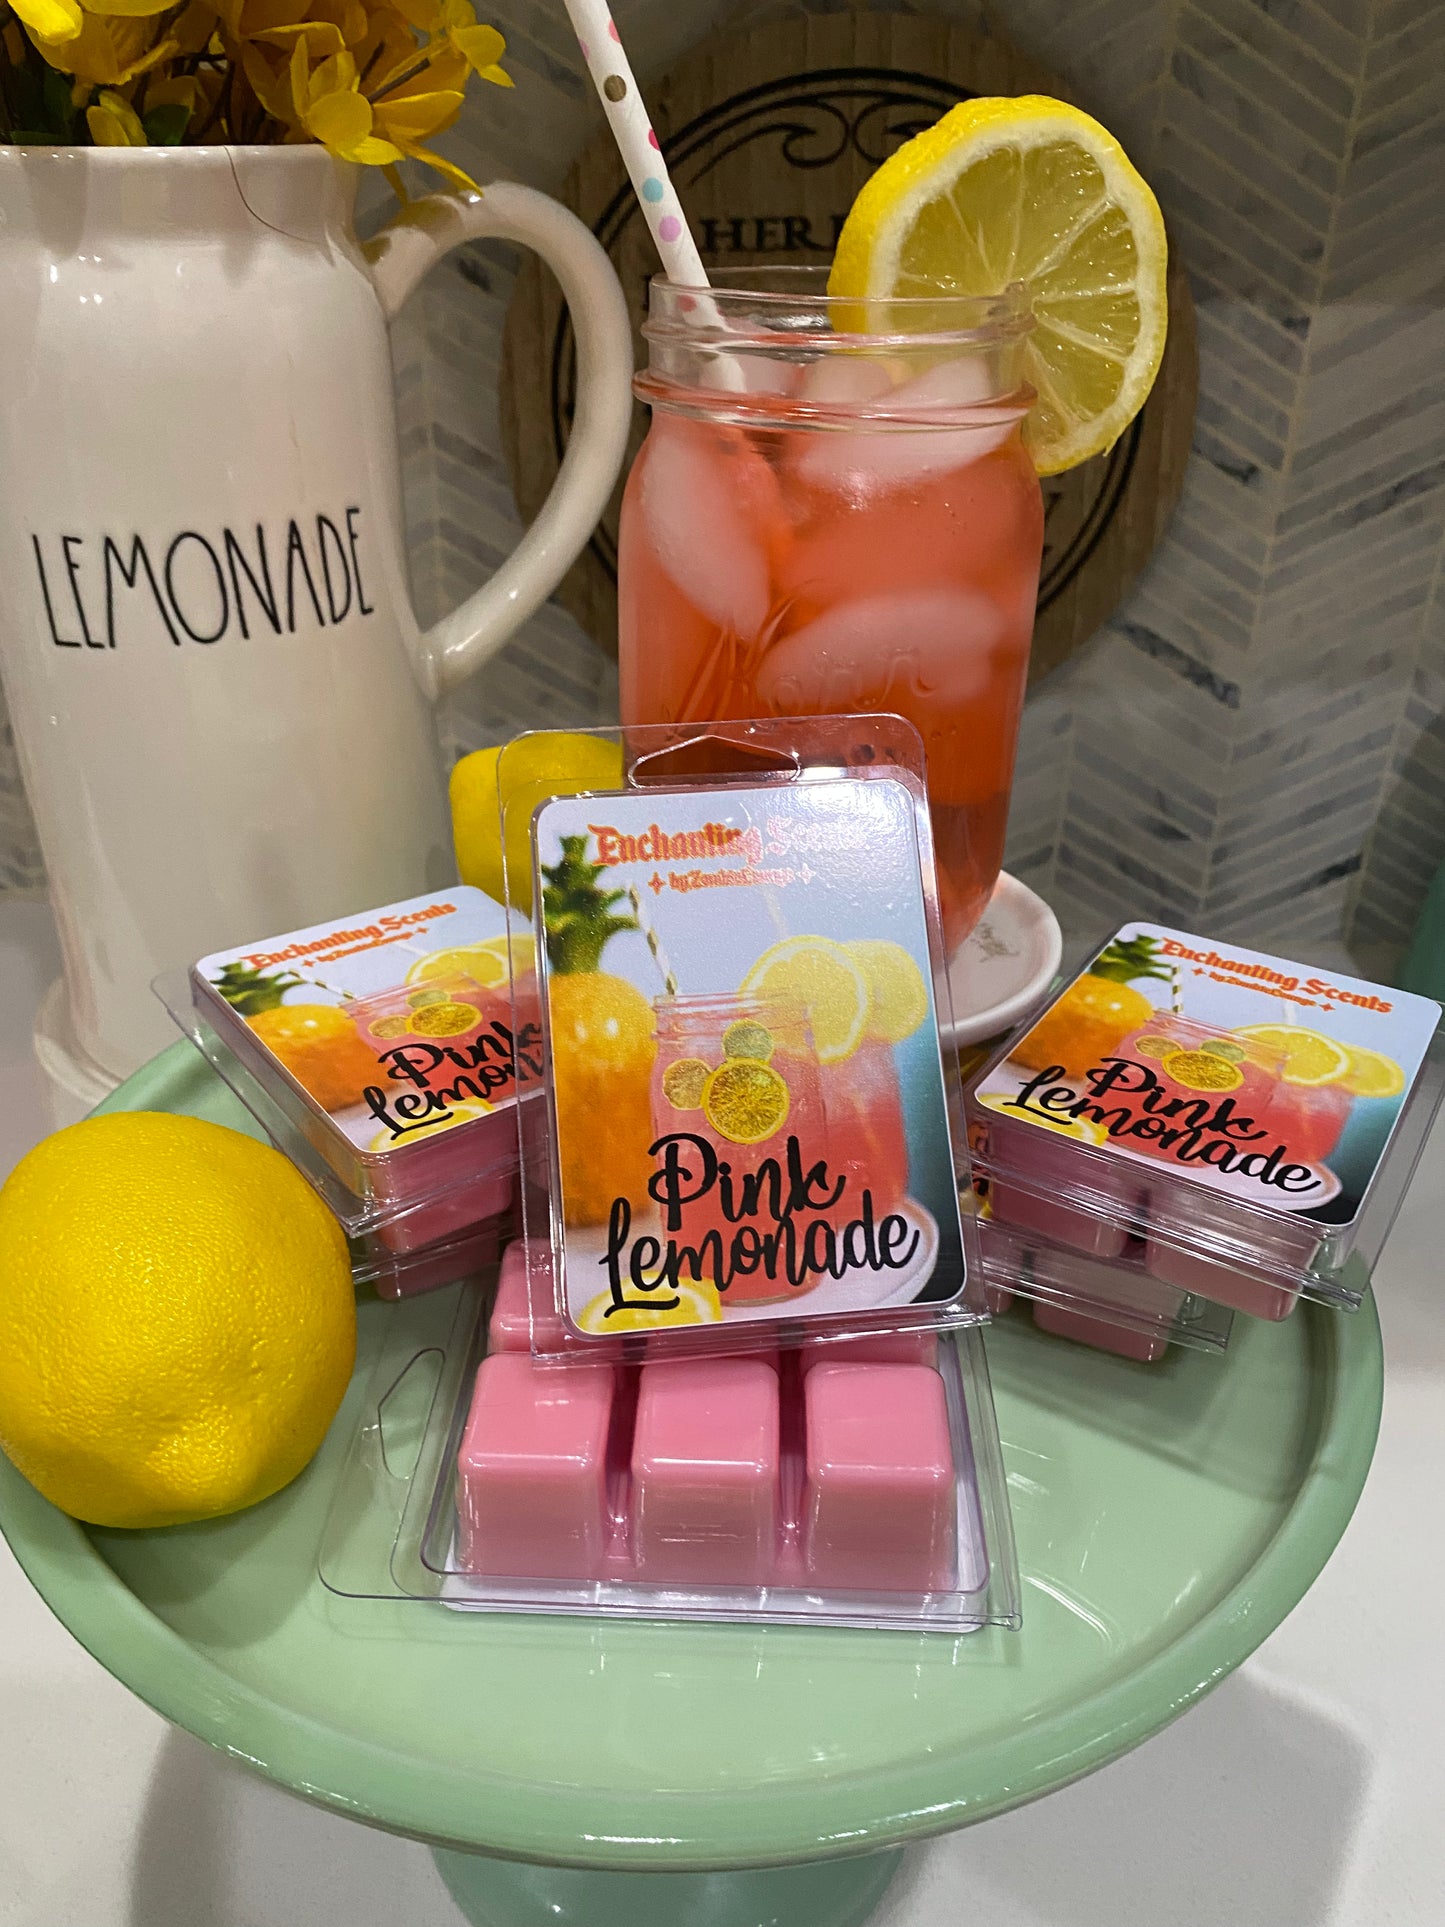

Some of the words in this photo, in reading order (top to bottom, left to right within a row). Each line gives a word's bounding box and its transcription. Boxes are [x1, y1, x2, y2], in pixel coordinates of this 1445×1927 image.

[33, 507, 374, 649] LEMONADE
[588, 822, 763, 866] Enchanting
[240, 924, 385, 970] Enchanting
[378, 903, 457, 933] Scents
[1160, 936, 1299, 991] Enchanting
[1298, 978, 1394, 1014] Scents
[1003, 1065, 1322, 1193] Lemonade
[1086, 1057, 1269, 1142] Pink
[647, 1132, 847, 1232] Pink
[598, 1189, 920, 1318] Lemonade
